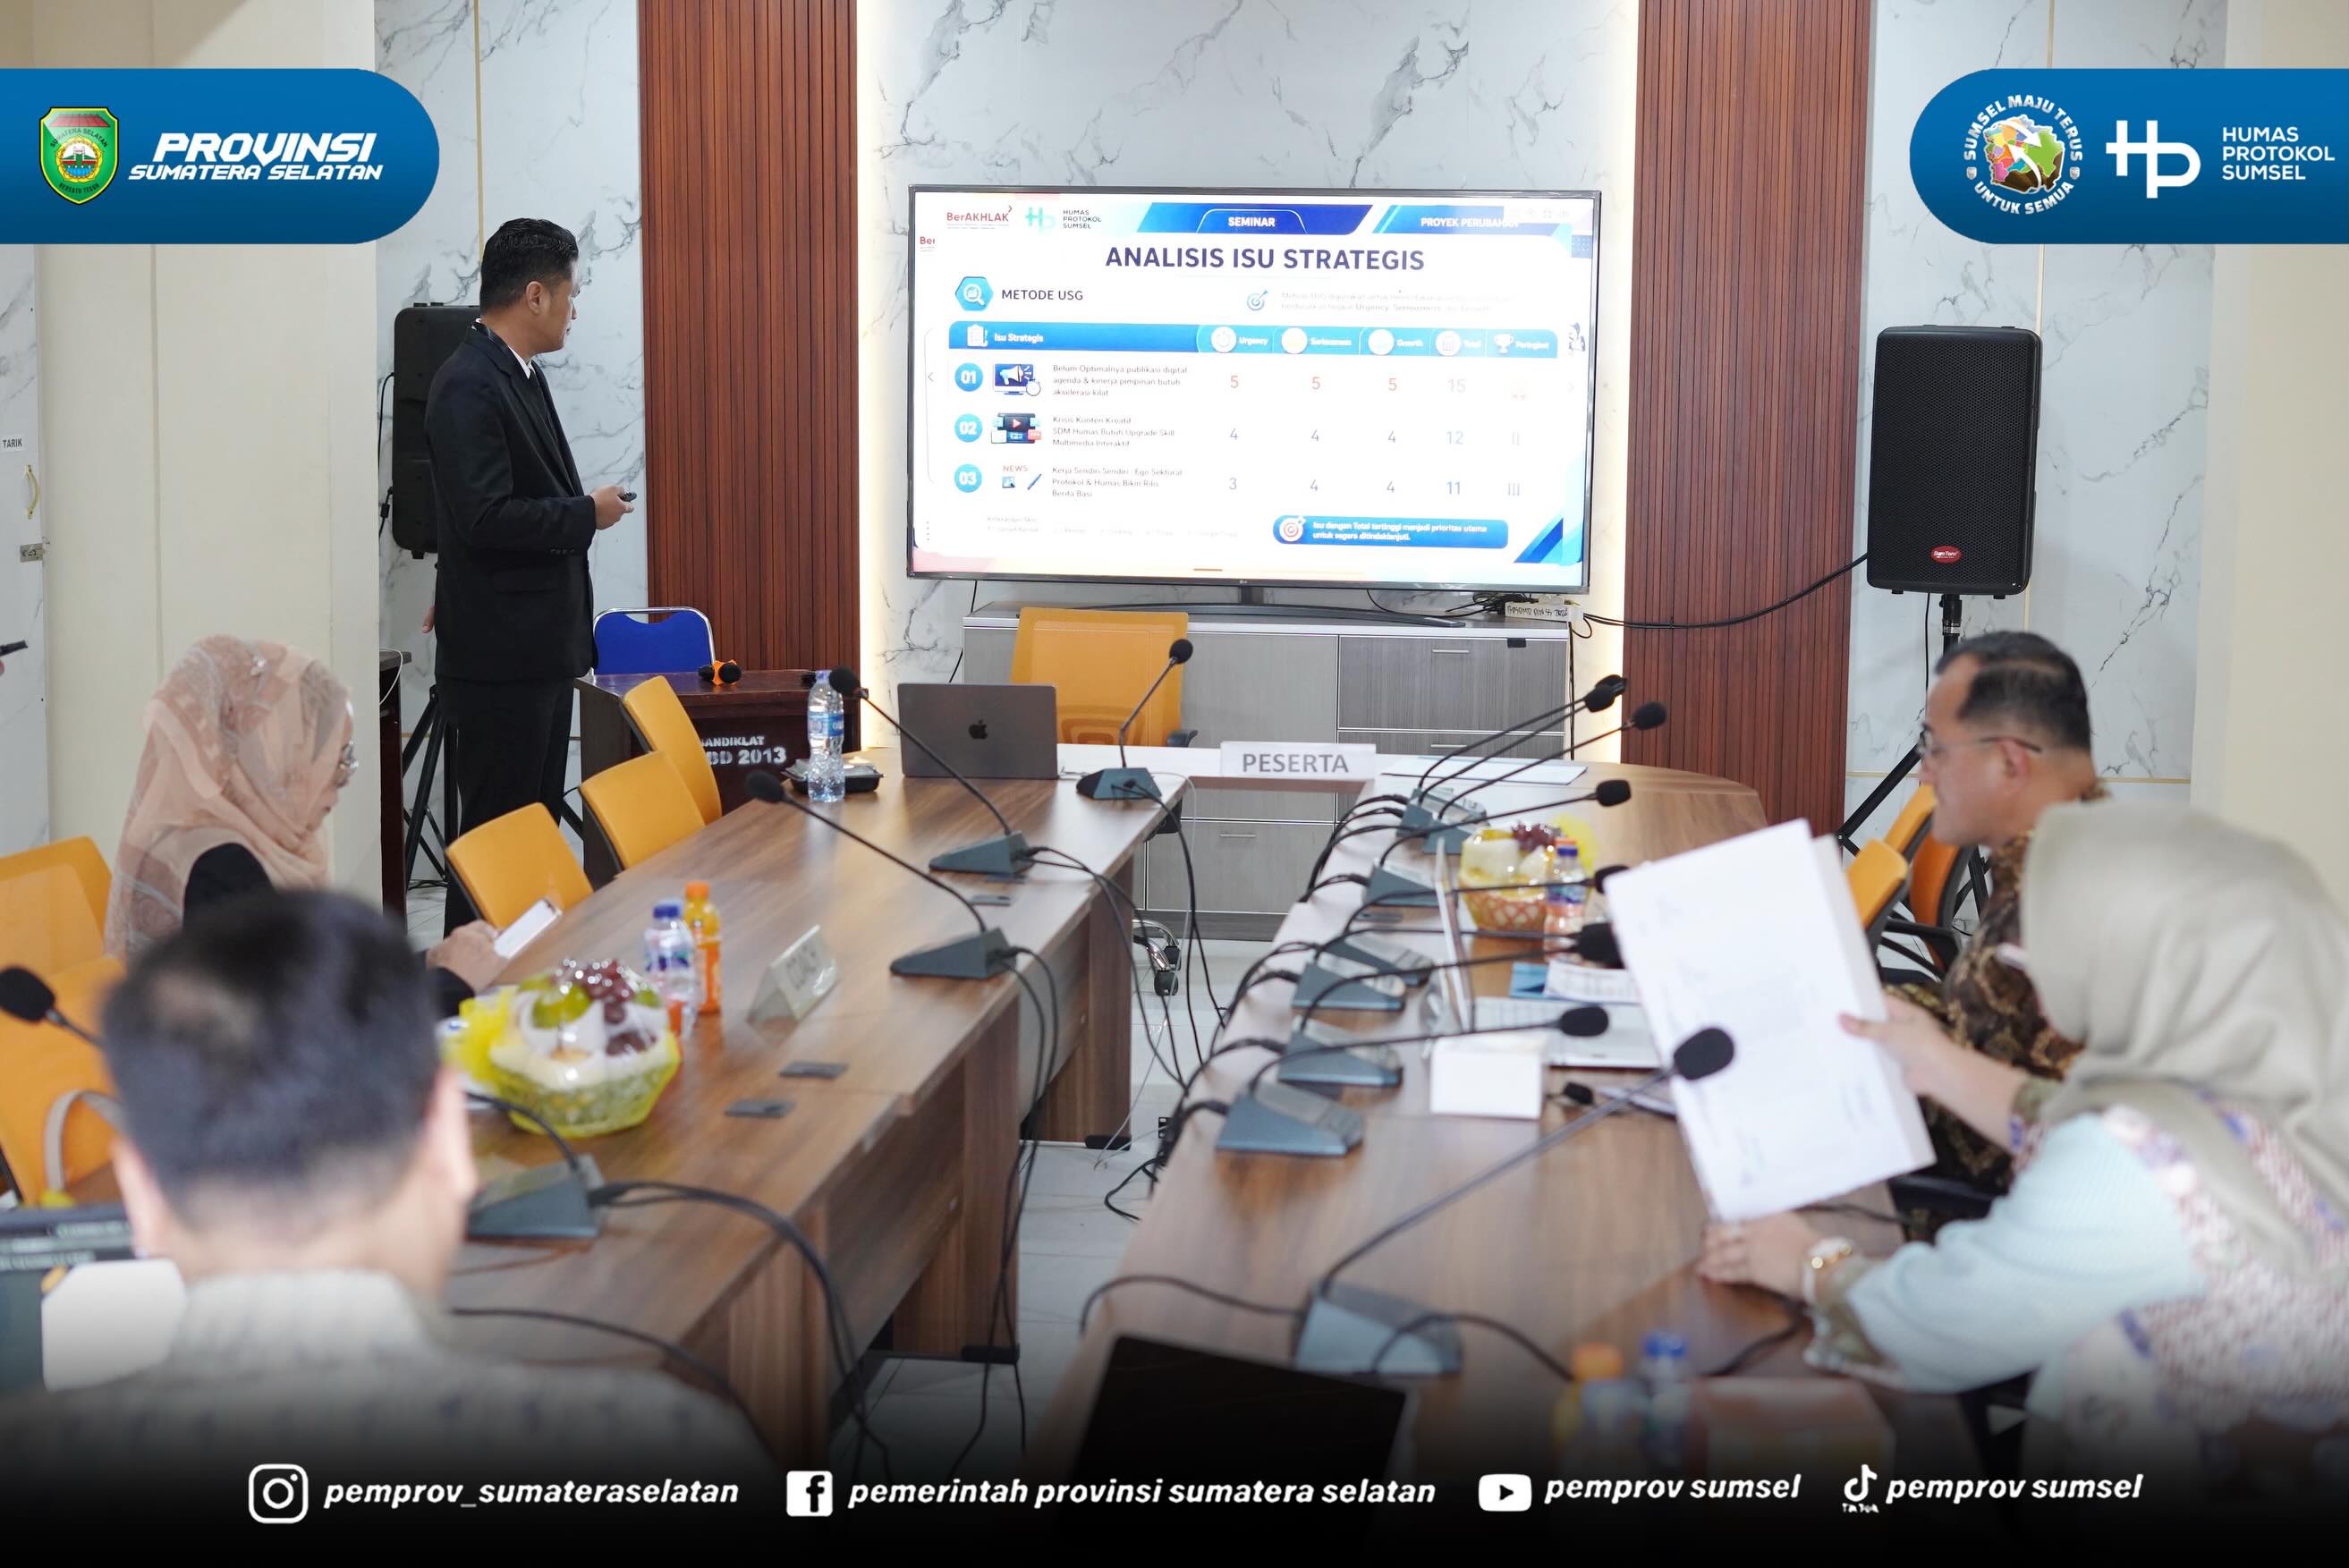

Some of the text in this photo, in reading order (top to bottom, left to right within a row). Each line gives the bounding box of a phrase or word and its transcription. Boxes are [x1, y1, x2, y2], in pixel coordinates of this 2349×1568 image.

[946, 212, 1009, 223] BerAKHLAK
[1228, 216, 1276, 228] SEMINAR
[1420, 217, 1458, 228] PROYEK
[1106, 247, 1425, 271] ANALISIS ISU STRATEGIS
[1002, 289, 1083, 301] METODE USG
[994, 333, 1044, 344] Isu Strategis
[1080, 365, 1124, 374] Optimalnya
[1126, 365, 1160, 375] publikasi
[1163, 366, 1187, 375] digital
[961, 371, 976, 385] 01
[1053, 377, 1081, 386] agenda
[1091, 377, 1117, 386] kinerja
[1230, 375, 1239, 388] 5
[1311, 377, 1321, 390] 5
[1388, 378, 1397, 392] 5
[1448, 378, 1466, 394] 15
[959, 422, 977, 436] 02
[1073, 428, 1098, 436] Humas
[1125, 428, 1158, 437] Upgrade
[1230, 428, 1238, 440] 4
[1310, 429, 1319, 442] 4
[3, 437, 22, 449] TARIK
[1387, 430, 1395, 443] 4
[1446, 430, 1463, 445] 12
[959, 471, 977, 485] 03
[1229, 478, 1237, 490] 3
[1310, 479, 1319, 492] 4
[1387, 480, 1395, 493] 4
[1446, 481, 1461, 495] 11
[1313, 521, 1325, 530] Isu
[1326, 521, 1352, 530] dengan
[1353, 521, 1371, 530] Total
[738, 746, 787, 765] 2013
[1242, 753, 1349, 773] PESERTA
